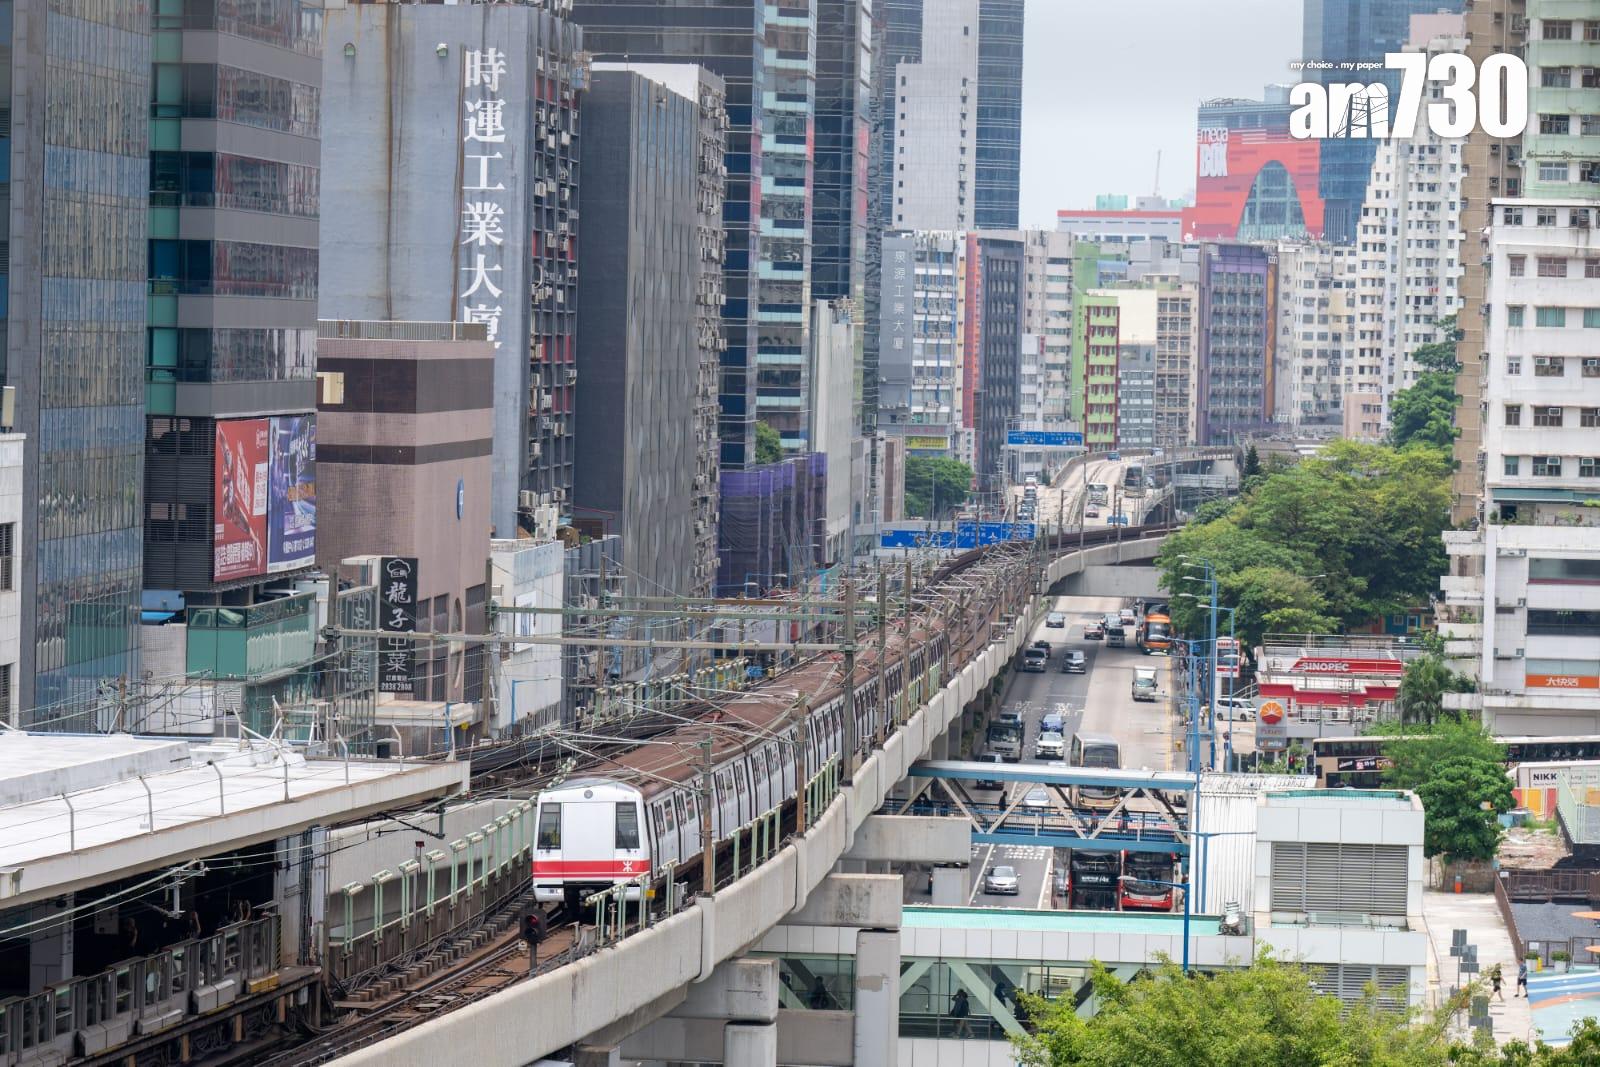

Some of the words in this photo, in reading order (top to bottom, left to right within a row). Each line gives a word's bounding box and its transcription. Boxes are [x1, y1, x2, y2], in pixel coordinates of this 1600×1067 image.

[1200, 127, 1228, 143] mega
[1199, 142, 1228, 176] BOX
[1302, 661, 1349, 672] SINOPEC
[1546, 677, 1578, 687] 大快活
